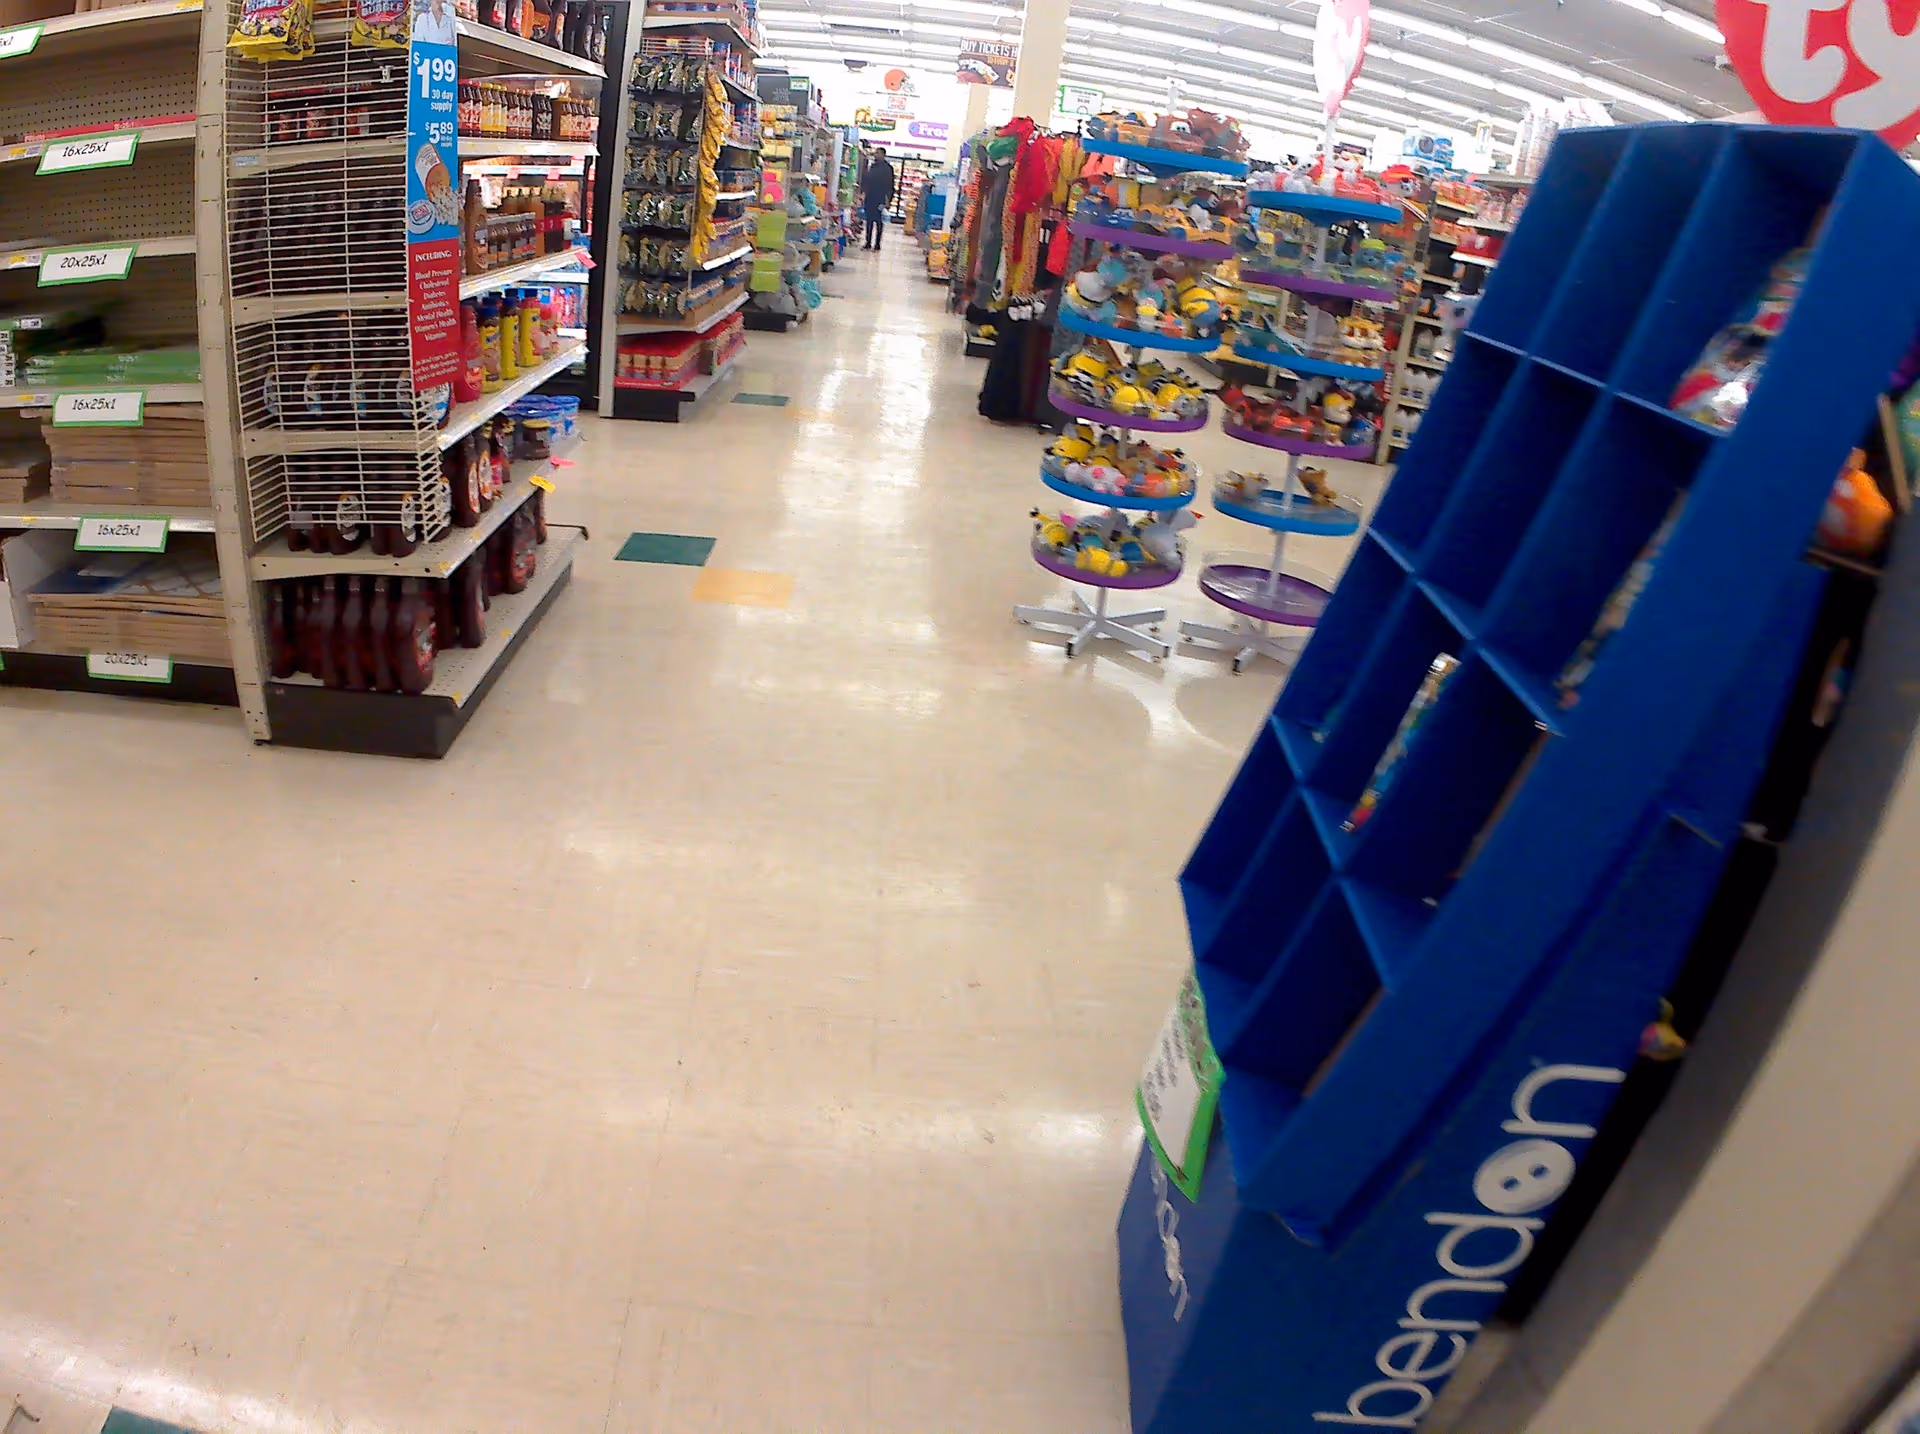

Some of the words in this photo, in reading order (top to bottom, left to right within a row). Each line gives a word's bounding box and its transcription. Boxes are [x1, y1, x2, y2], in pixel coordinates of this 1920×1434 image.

[960, 39, 977, 52] BUY
[979, 41, 1010, 57] TICKETS
[1748, 0, 1920, 131] ty
[431, 89, 440, 99] 30
[441, 89, 454, 103] day
[430, 101, 453, 113] supply
[62, 141, 109, 158] 16x25x1
[60, 253, 107, 269] 20x25x1
[415, 271, 431, 281] Blood
[71, 398, 116, 411] 16x25x1
[104, 652, 148, 667] 20x25x1
[1311, 1063, 1627, 1428] bendon
